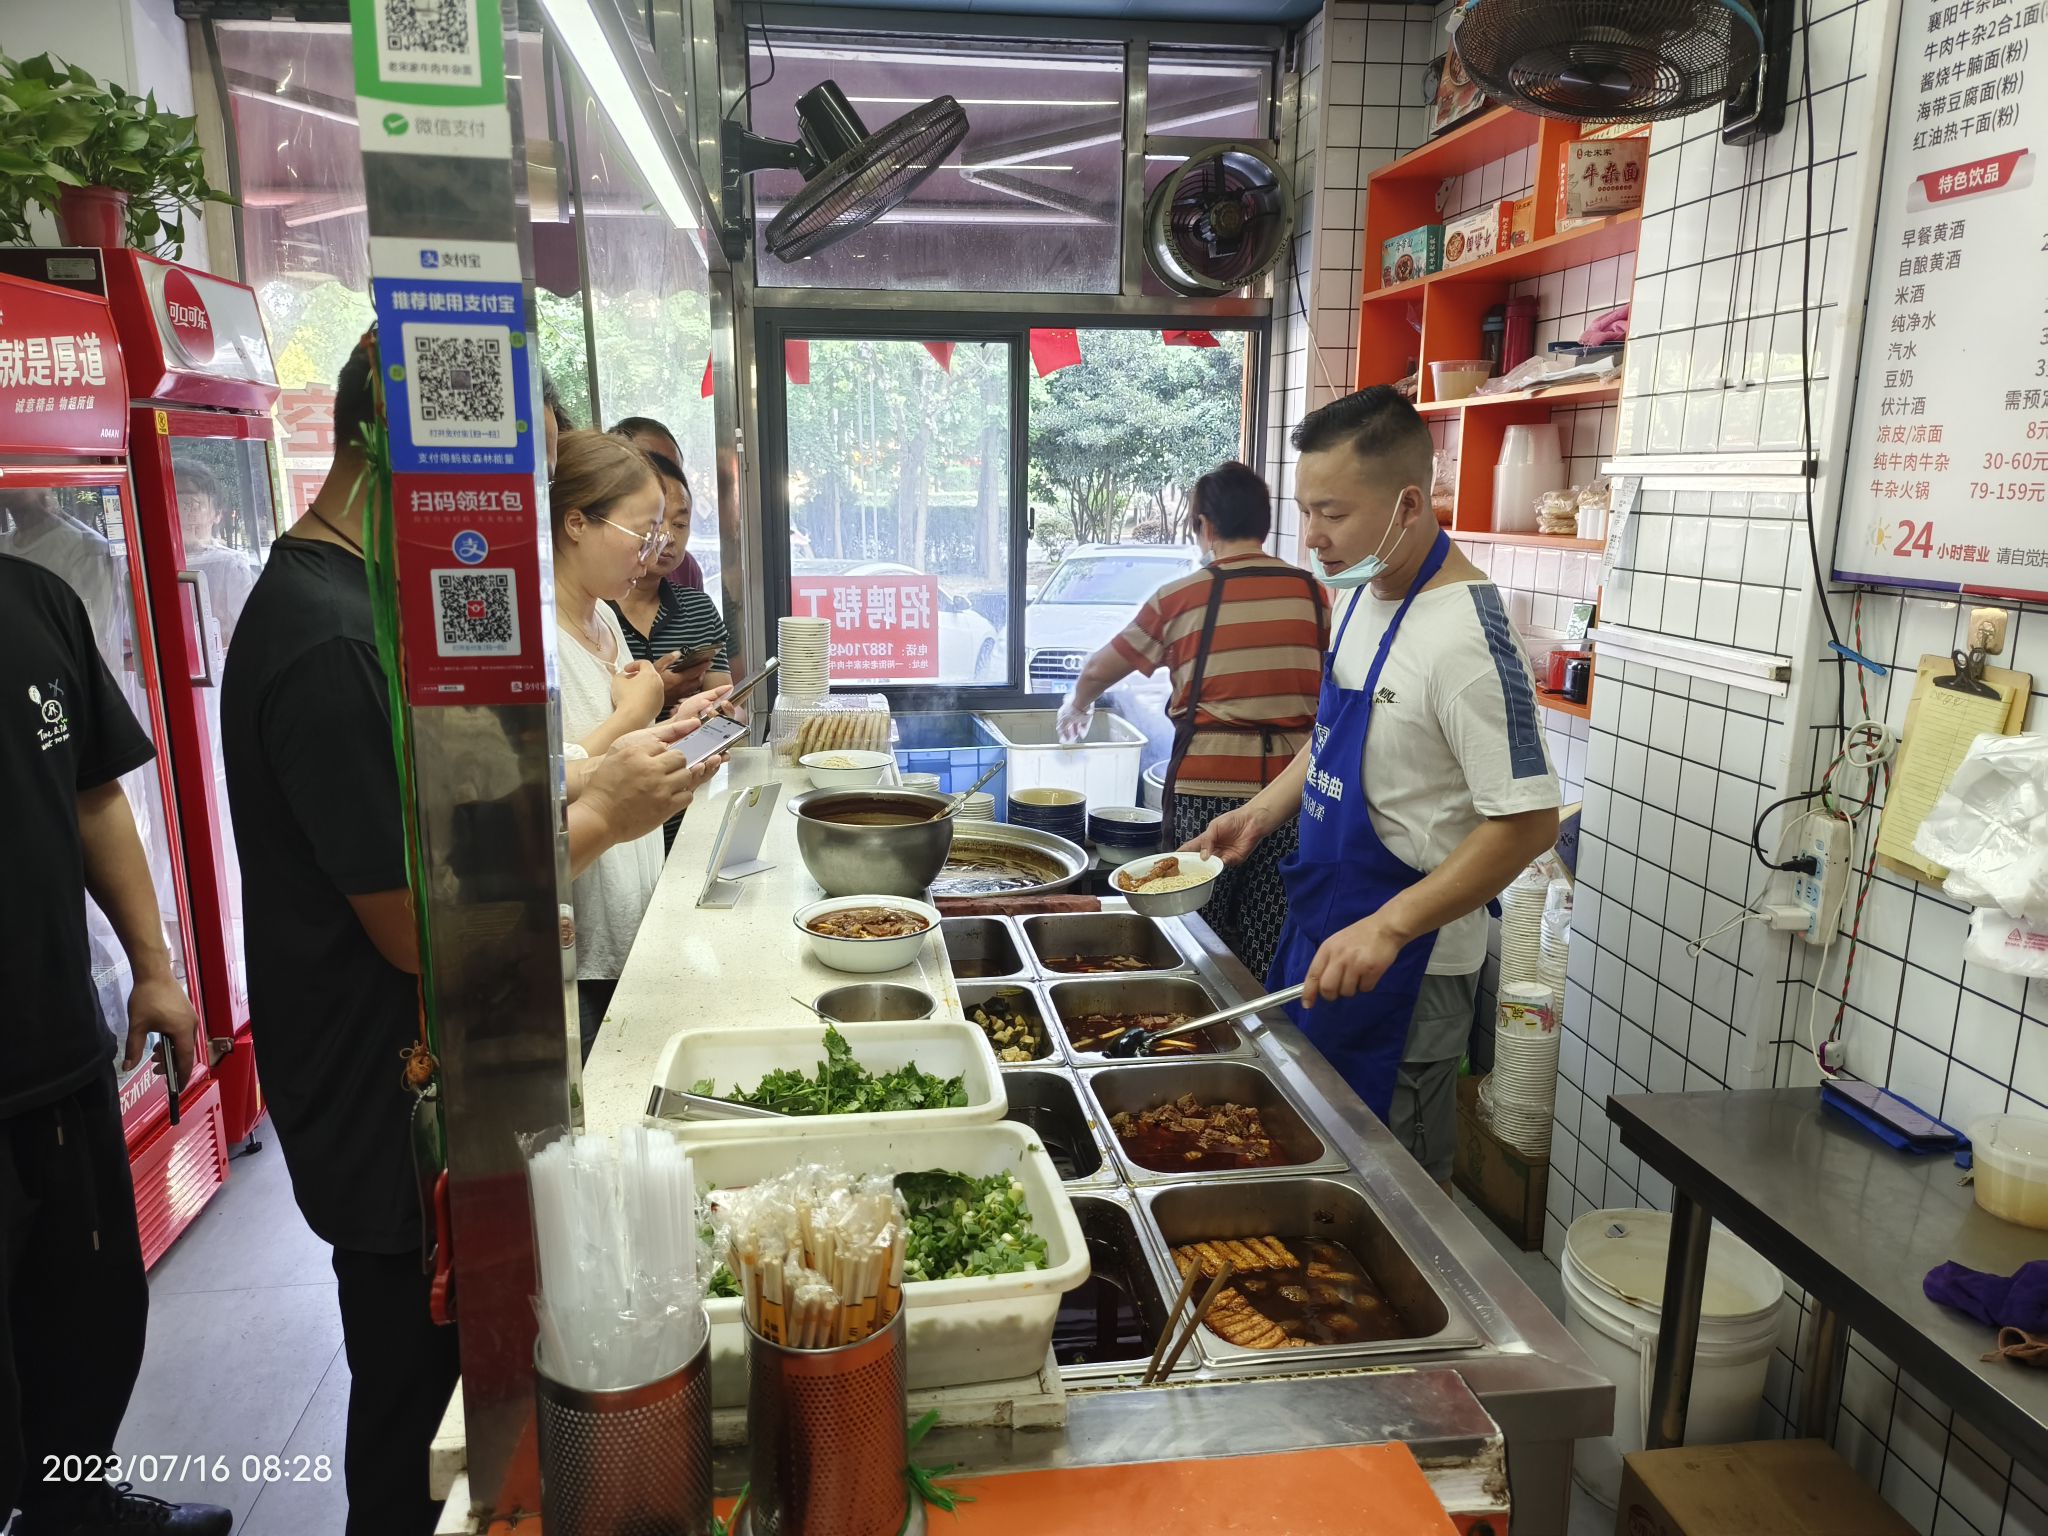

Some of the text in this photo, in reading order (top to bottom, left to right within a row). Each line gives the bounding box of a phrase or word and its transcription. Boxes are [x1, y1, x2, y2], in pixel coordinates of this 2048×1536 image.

[1920, 38, 2029, 94] 酱烧牛腩面(粉)
[1916, 70, 2024, 122] 海带豆腐面(粉)
[415, 117, 486, 138] 微信支付
[1912, 103, 2020, 151] 红油热干面(粉)
[1583, 161, 1640, 187] 牛杂面
[1938, 162, 1999, 195] 特色饮品
[1901, 219, 1965, 248] 早餐黄酒
[441, 253, 481, 268] 支付宝
[1898, 249, 1962, 277] 自酿黄酒
[391, 291, 516, 314] 推荐使用支付宝
[1894, 284, 1925, 305] 米酒
[168, 301, 208, 330] 可口可乐
[1890, 310, 1936, 333] 纯净水
[0, 332, 107, 388] 就是厚道
[1887, 340, 1917, 361] 汽水
[1883, 368, 1914, 388] 豆奶
[59, 394, 96, 411] 物超所值
[1881, 396, 1926, 416] 伏汁酒
[1876, 424, 1943, 446] 凉皮/凉面
[1873, 452, 2048, 472] 纯牛肉牛杂 30-60元
[410, 490, 523, 512] 扫码领红包
[1870, 479, 2045, 502] 牛杂火锅 79-159元
[1893, 519, 1934, 558] 24
[1936, 543, 1990, 563] 小时营业
